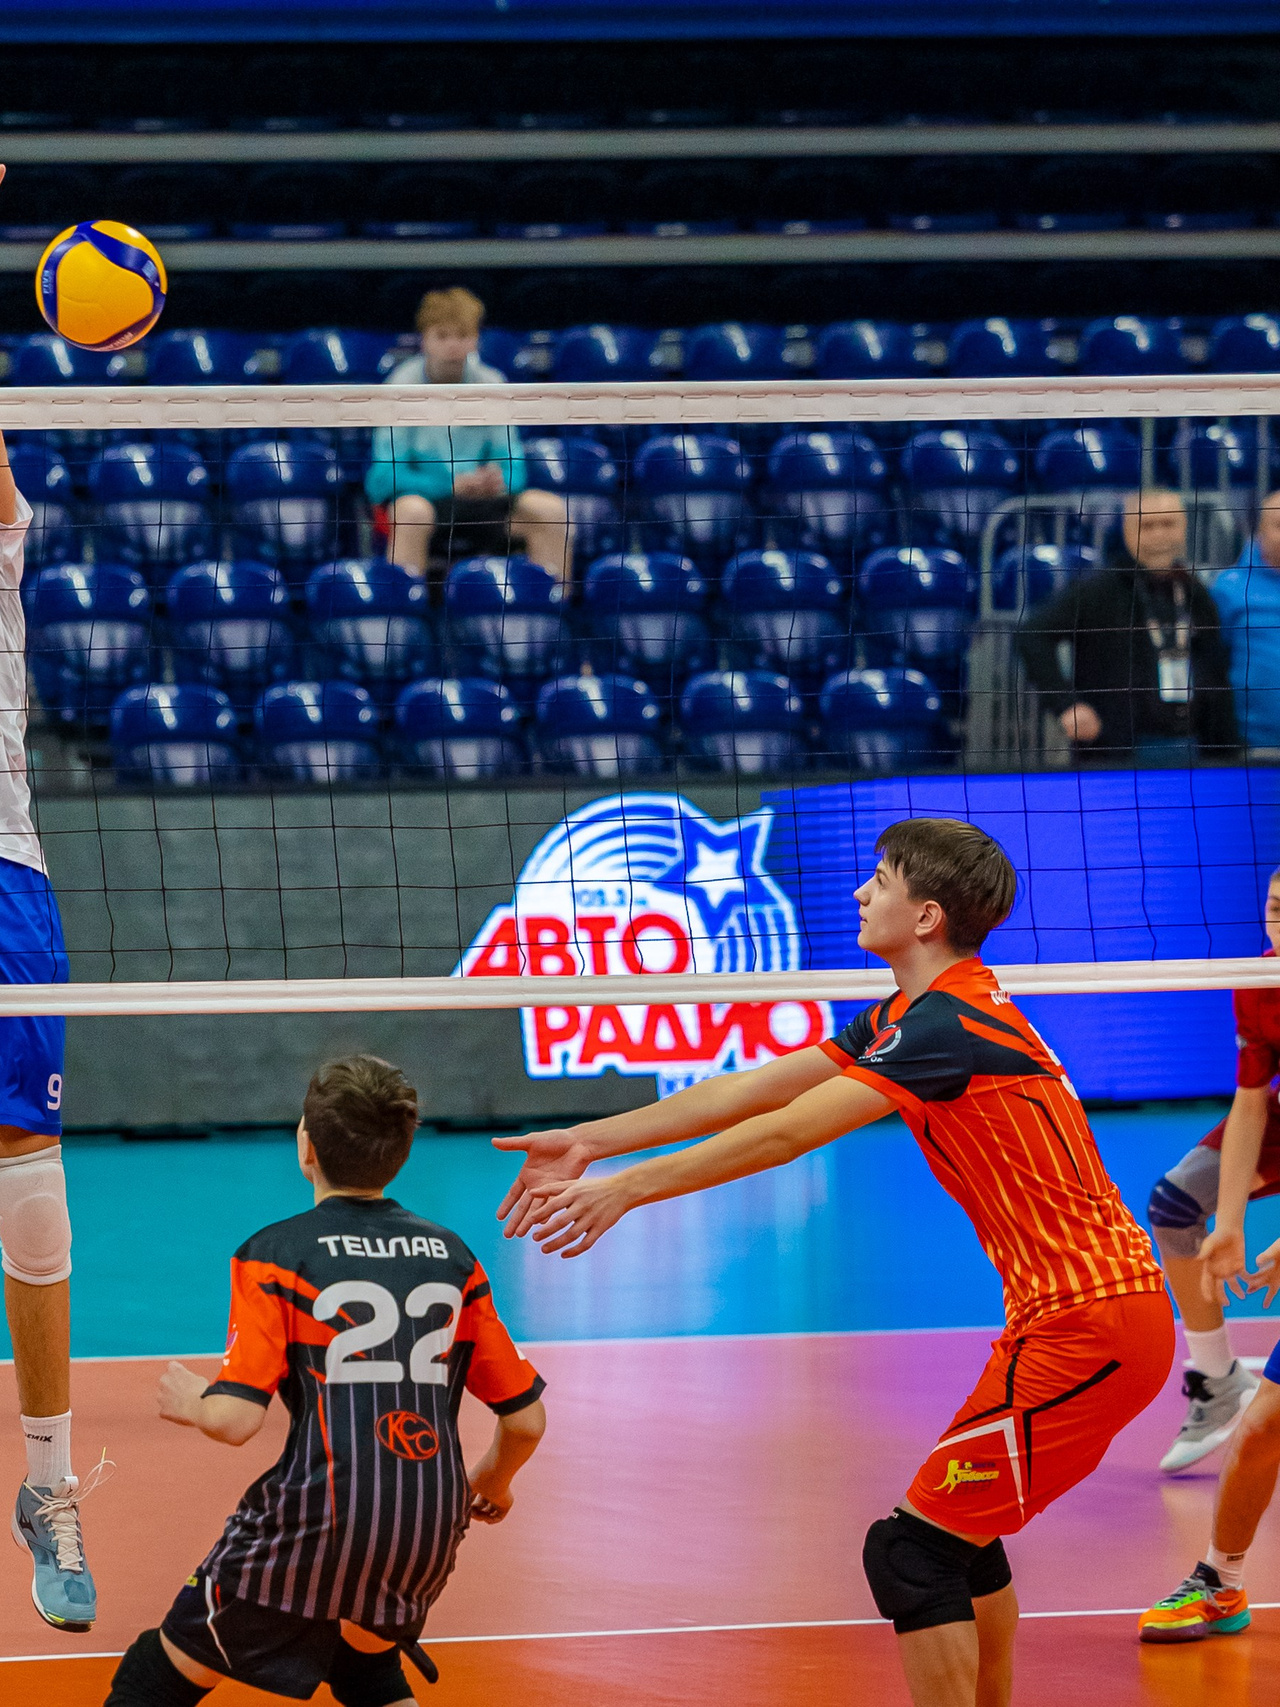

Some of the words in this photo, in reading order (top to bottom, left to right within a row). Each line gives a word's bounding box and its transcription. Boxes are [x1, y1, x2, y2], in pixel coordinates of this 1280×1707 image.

[467, 913, 691, 977] АВТО
[532, 1002, 824, 1065] РАДИО
[47, 1073, 63, 1111] 9
[317, 1234, 449, 1260] ТЕЦЛАВ
[312, 1280, 463, 1386] 22
[25, 1433, 53, 1443] EMIX
